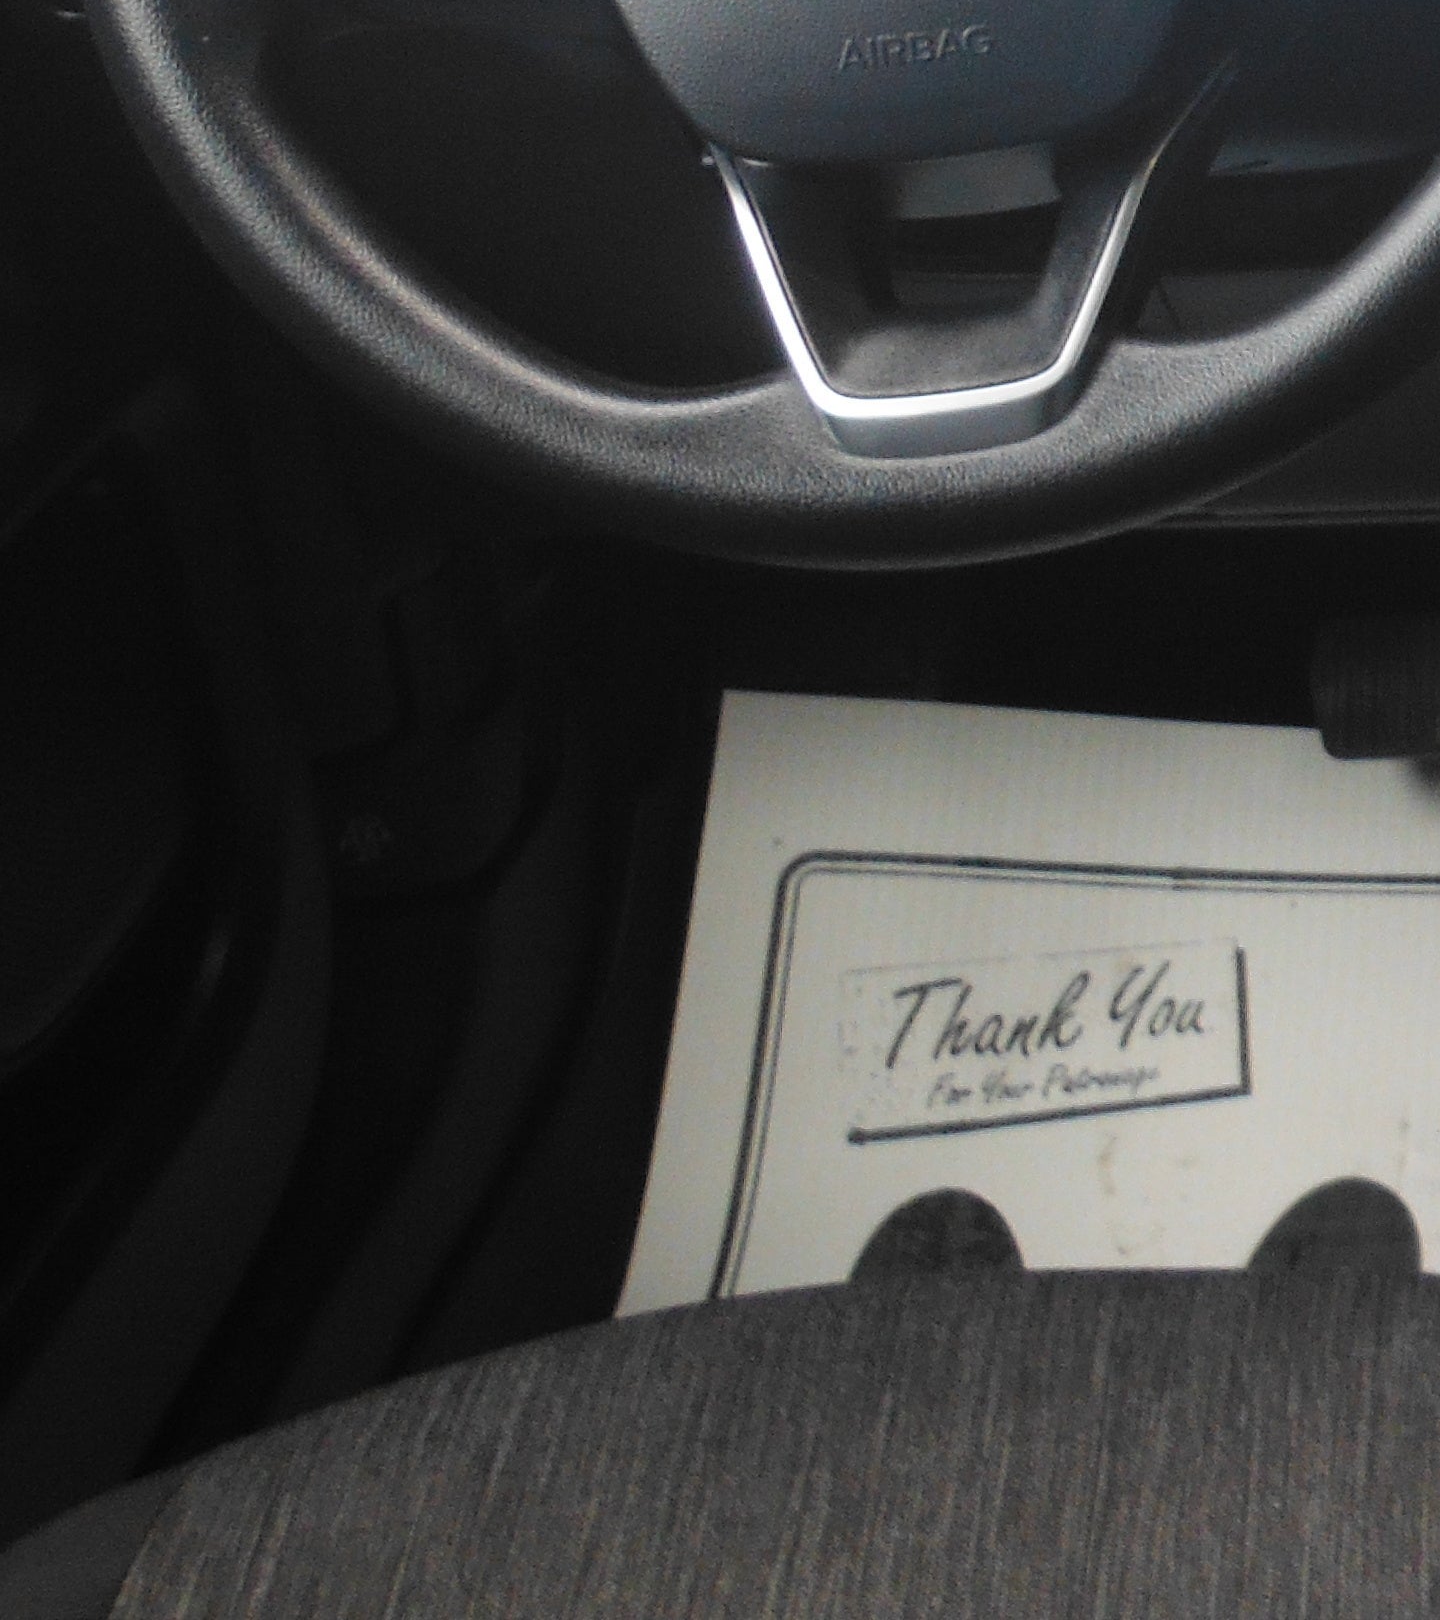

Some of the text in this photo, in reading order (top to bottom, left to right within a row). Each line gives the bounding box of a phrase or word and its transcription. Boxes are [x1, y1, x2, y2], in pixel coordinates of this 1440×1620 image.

[838, 25, 994, 72] AIRBAG
[884, 959, 1205, 1070] Thank You
